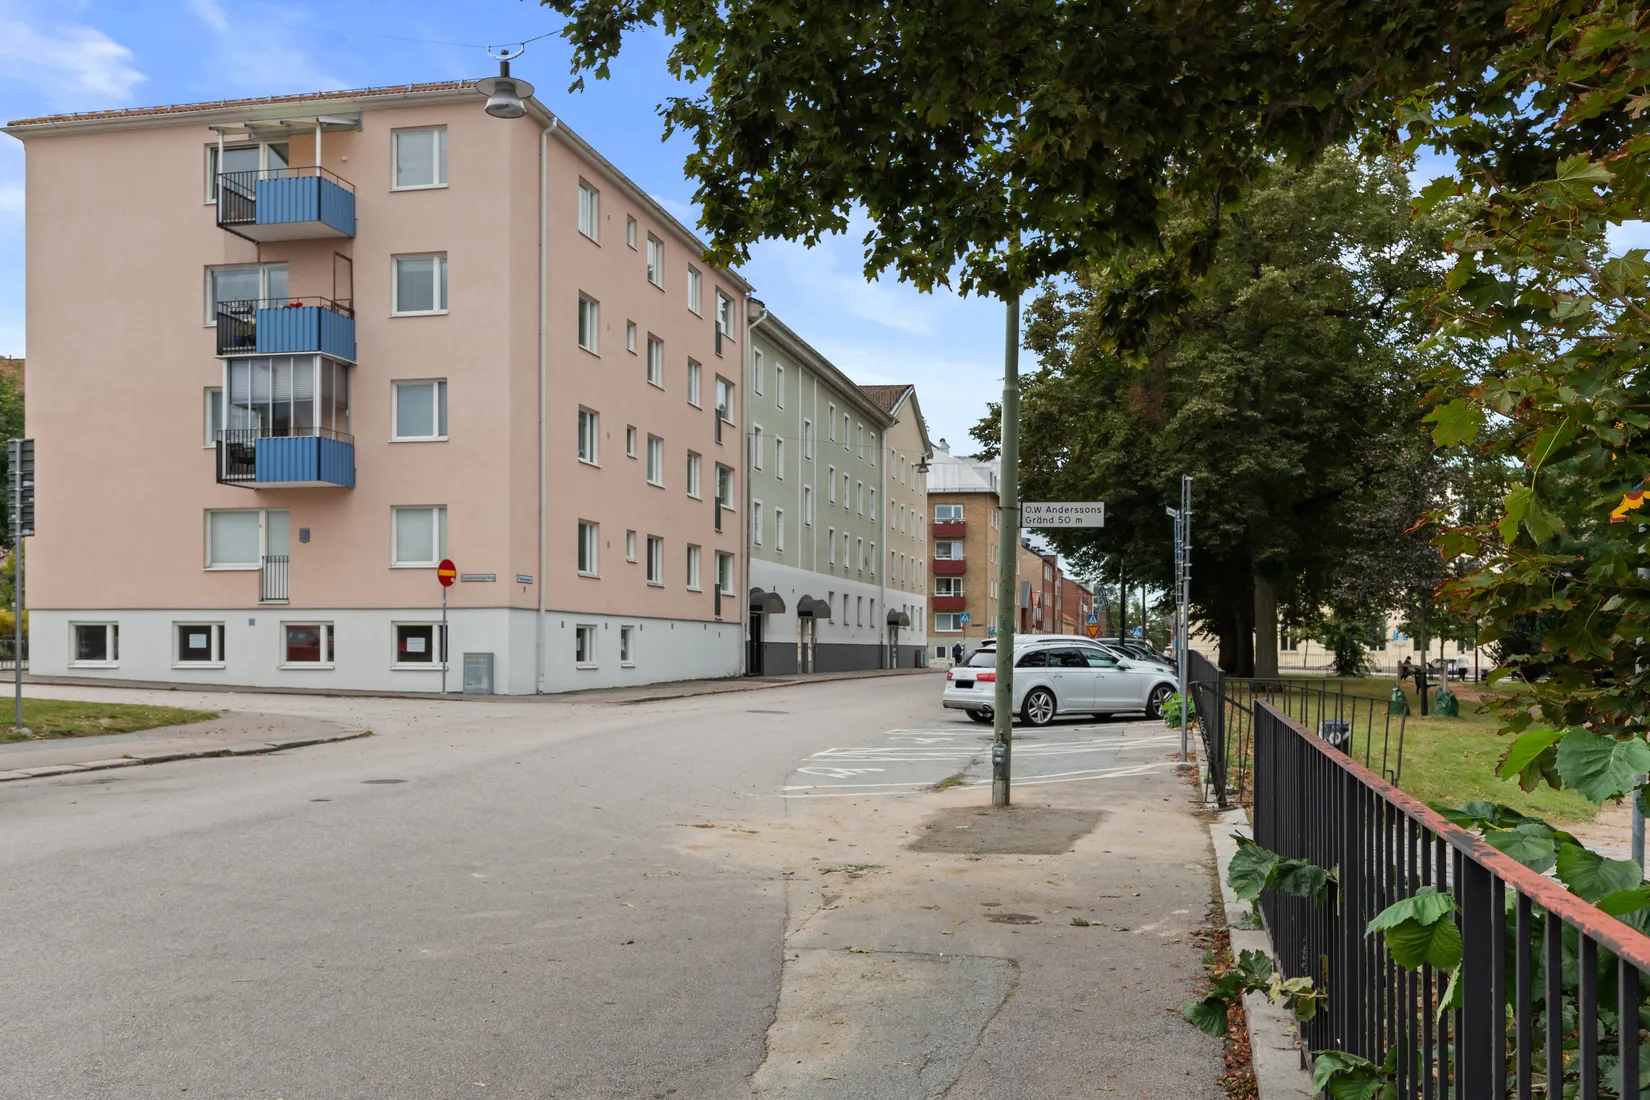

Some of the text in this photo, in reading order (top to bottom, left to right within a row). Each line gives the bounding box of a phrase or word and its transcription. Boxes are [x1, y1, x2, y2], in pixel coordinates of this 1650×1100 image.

[1025, 506, 1102, 514] O.W Anderssons
[1025, 516, 1054, 524] Gränd
[1058, 516, 1071, 524] 50
